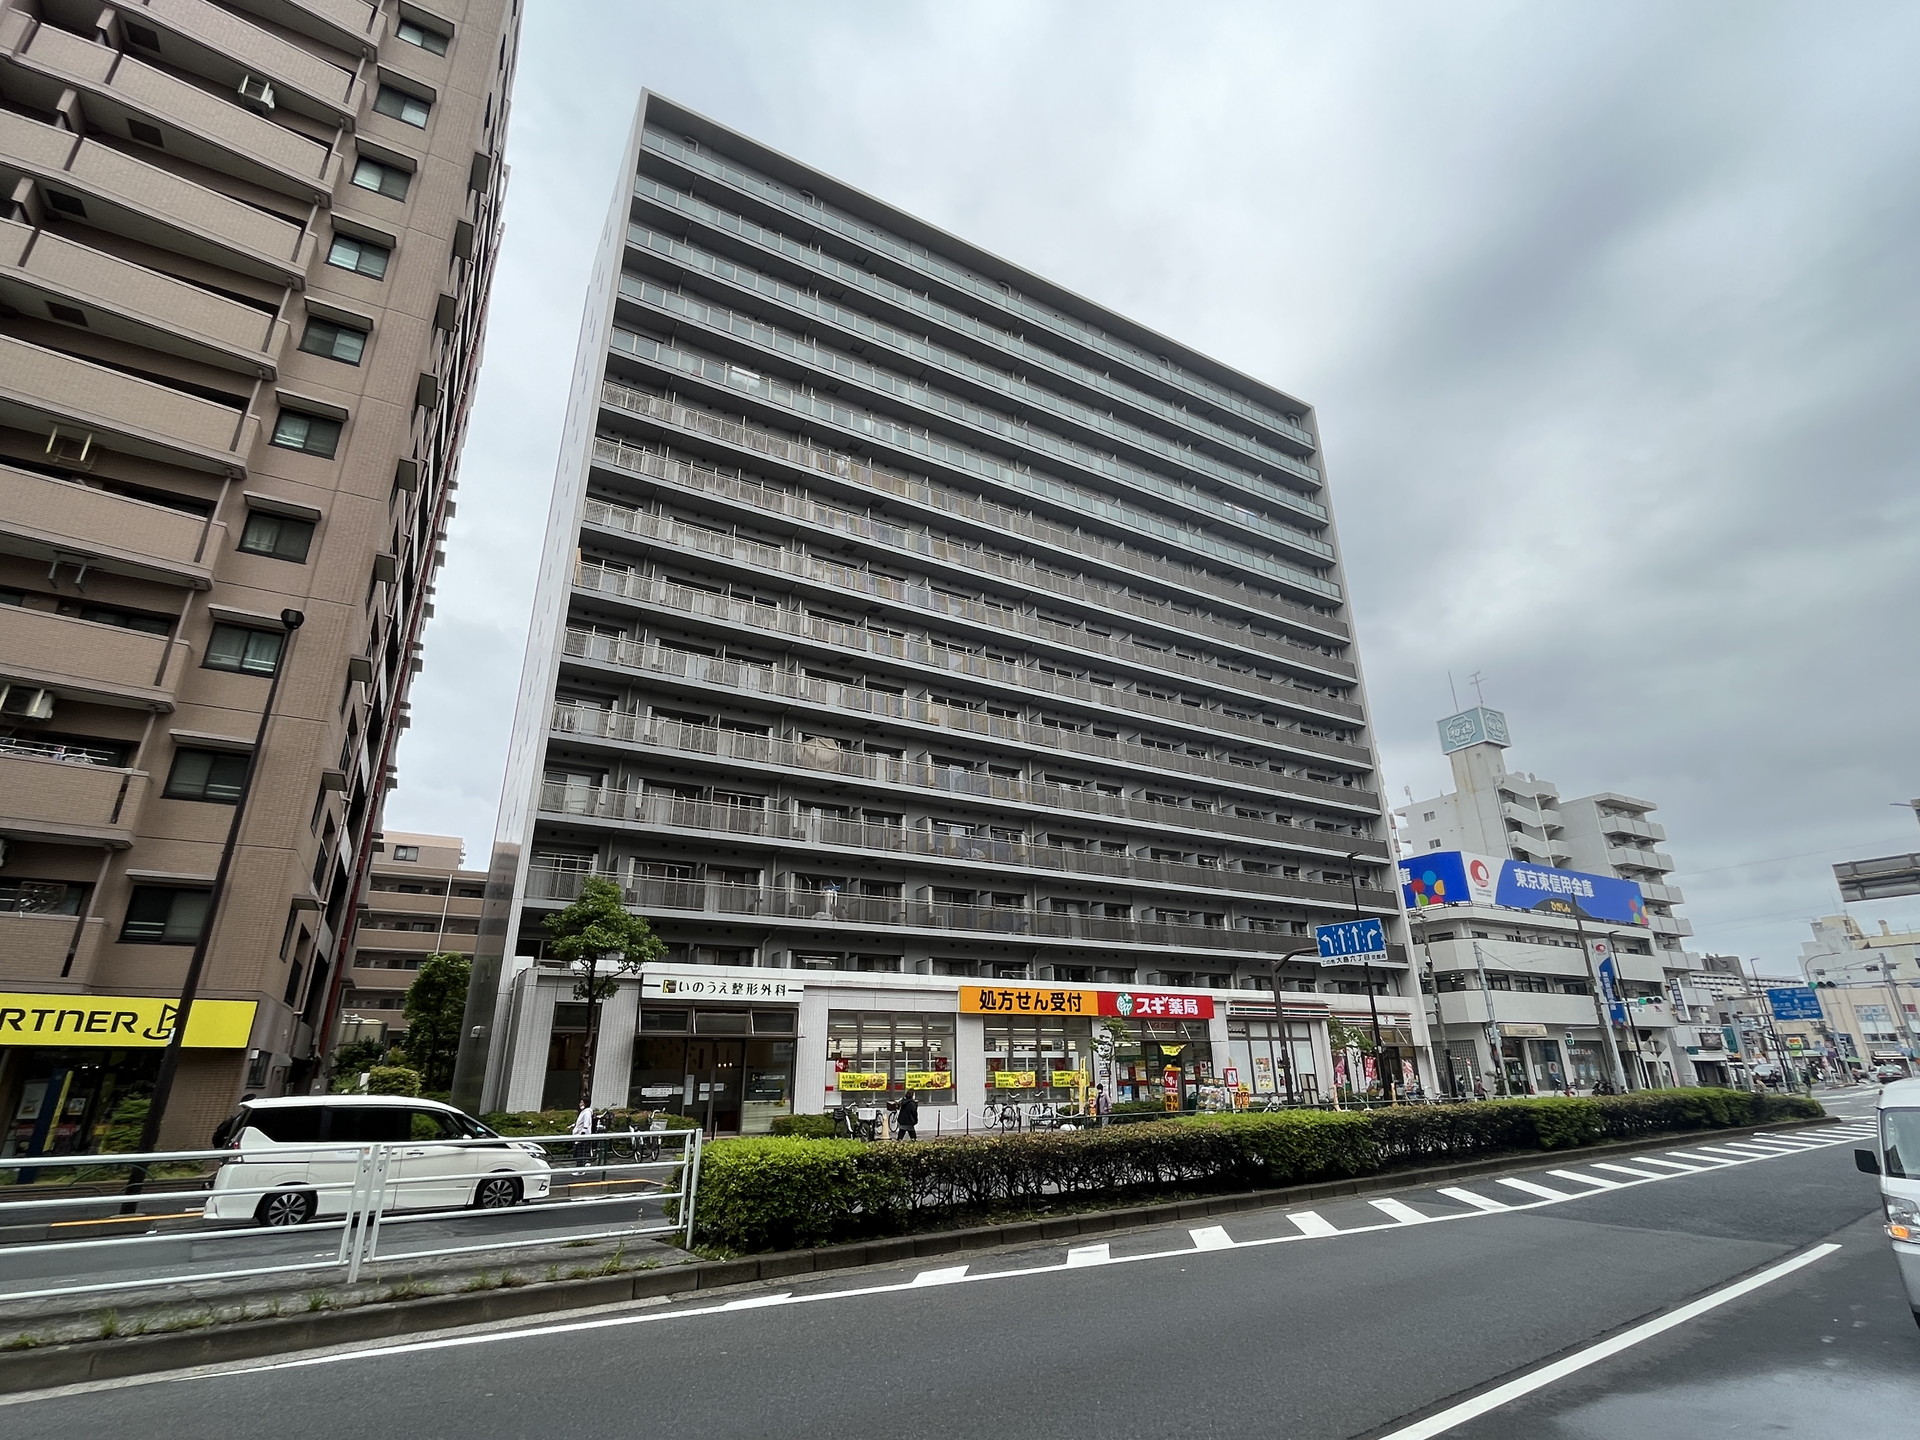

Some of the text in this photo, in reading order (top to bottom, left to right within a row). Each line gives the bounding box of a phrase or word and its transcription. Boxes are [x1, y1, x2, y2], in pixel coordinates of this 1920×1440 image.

[1514, 868, 1594, 897] 東京東信用金庫
[678, 982, 786, 997] いのうえ整形外科
[980, 989, 1083, 1013] 処方せん受付
[1136, 996, 1198, 1015] スギ薬局
